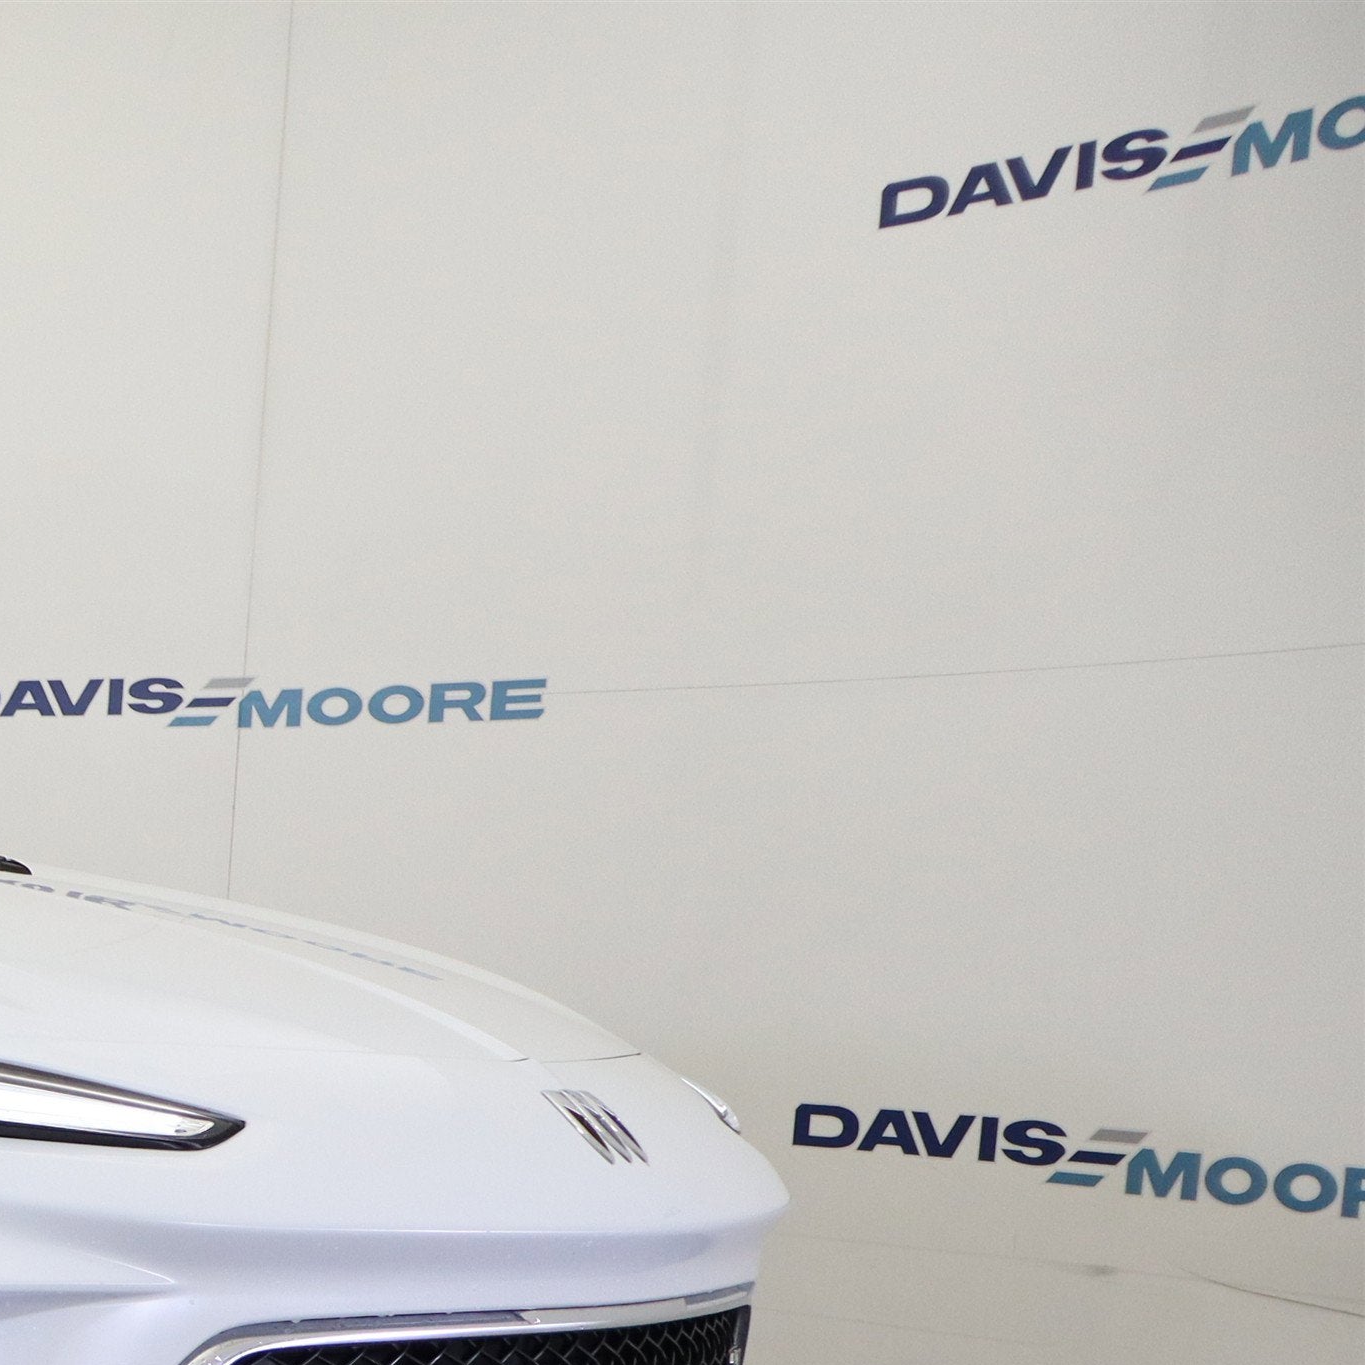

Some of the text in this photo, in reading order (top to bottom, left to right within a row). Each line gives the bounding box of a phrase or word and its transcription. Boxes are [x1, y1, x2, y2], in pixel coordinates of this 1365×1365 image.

[878, 127, 1170, 230] DAVIS
[236, 677, 548, 729] MOORE
[791, 1102, 1069, 1167] DAVIS
